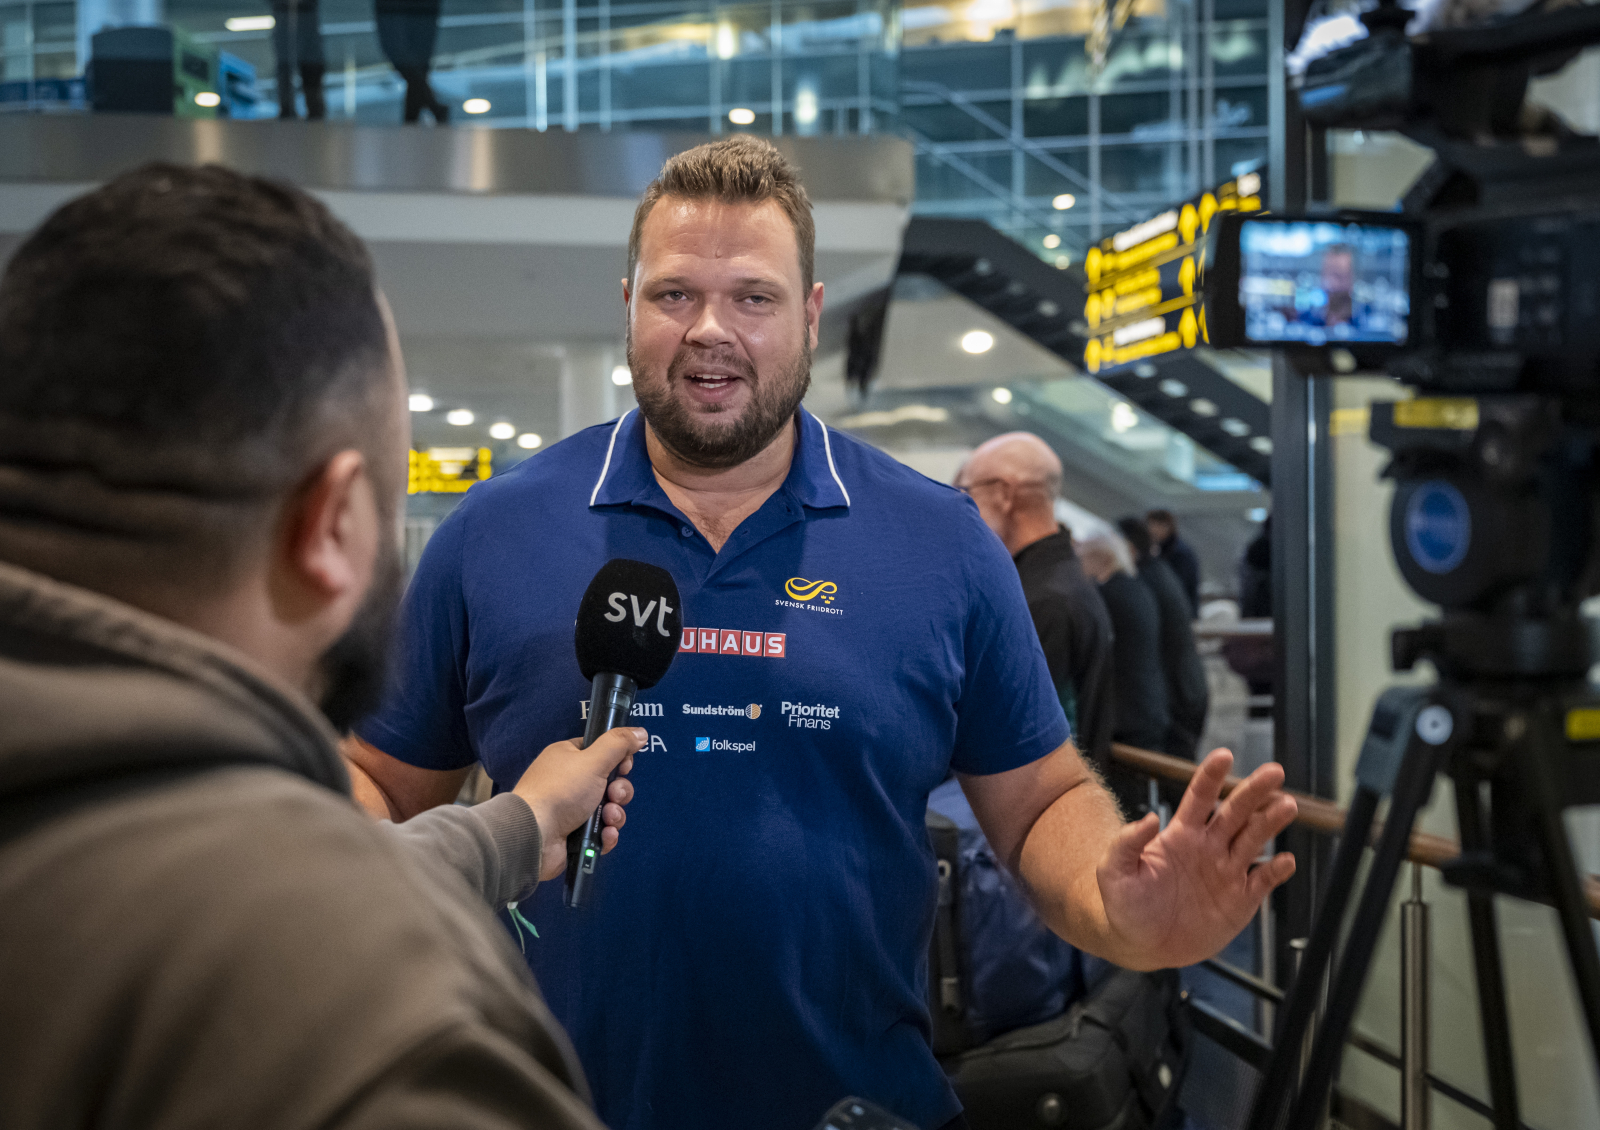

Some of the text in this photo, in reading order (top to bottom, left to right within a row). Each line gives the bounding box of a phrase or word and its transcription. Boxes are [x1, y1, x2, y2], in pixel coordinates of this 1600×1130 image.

[603, 592, 674, 637] svt
[774, 599, 844, 616] SVENSK FRIIDROTT
[680, 630, 783, 655] UHAUS
[682, 703, 745, 717] Sundström
[781, 701, 840, 719] Prioritet
[788, 714, 831, 730] Finans
[712, 739, 756, 753] folkspel
